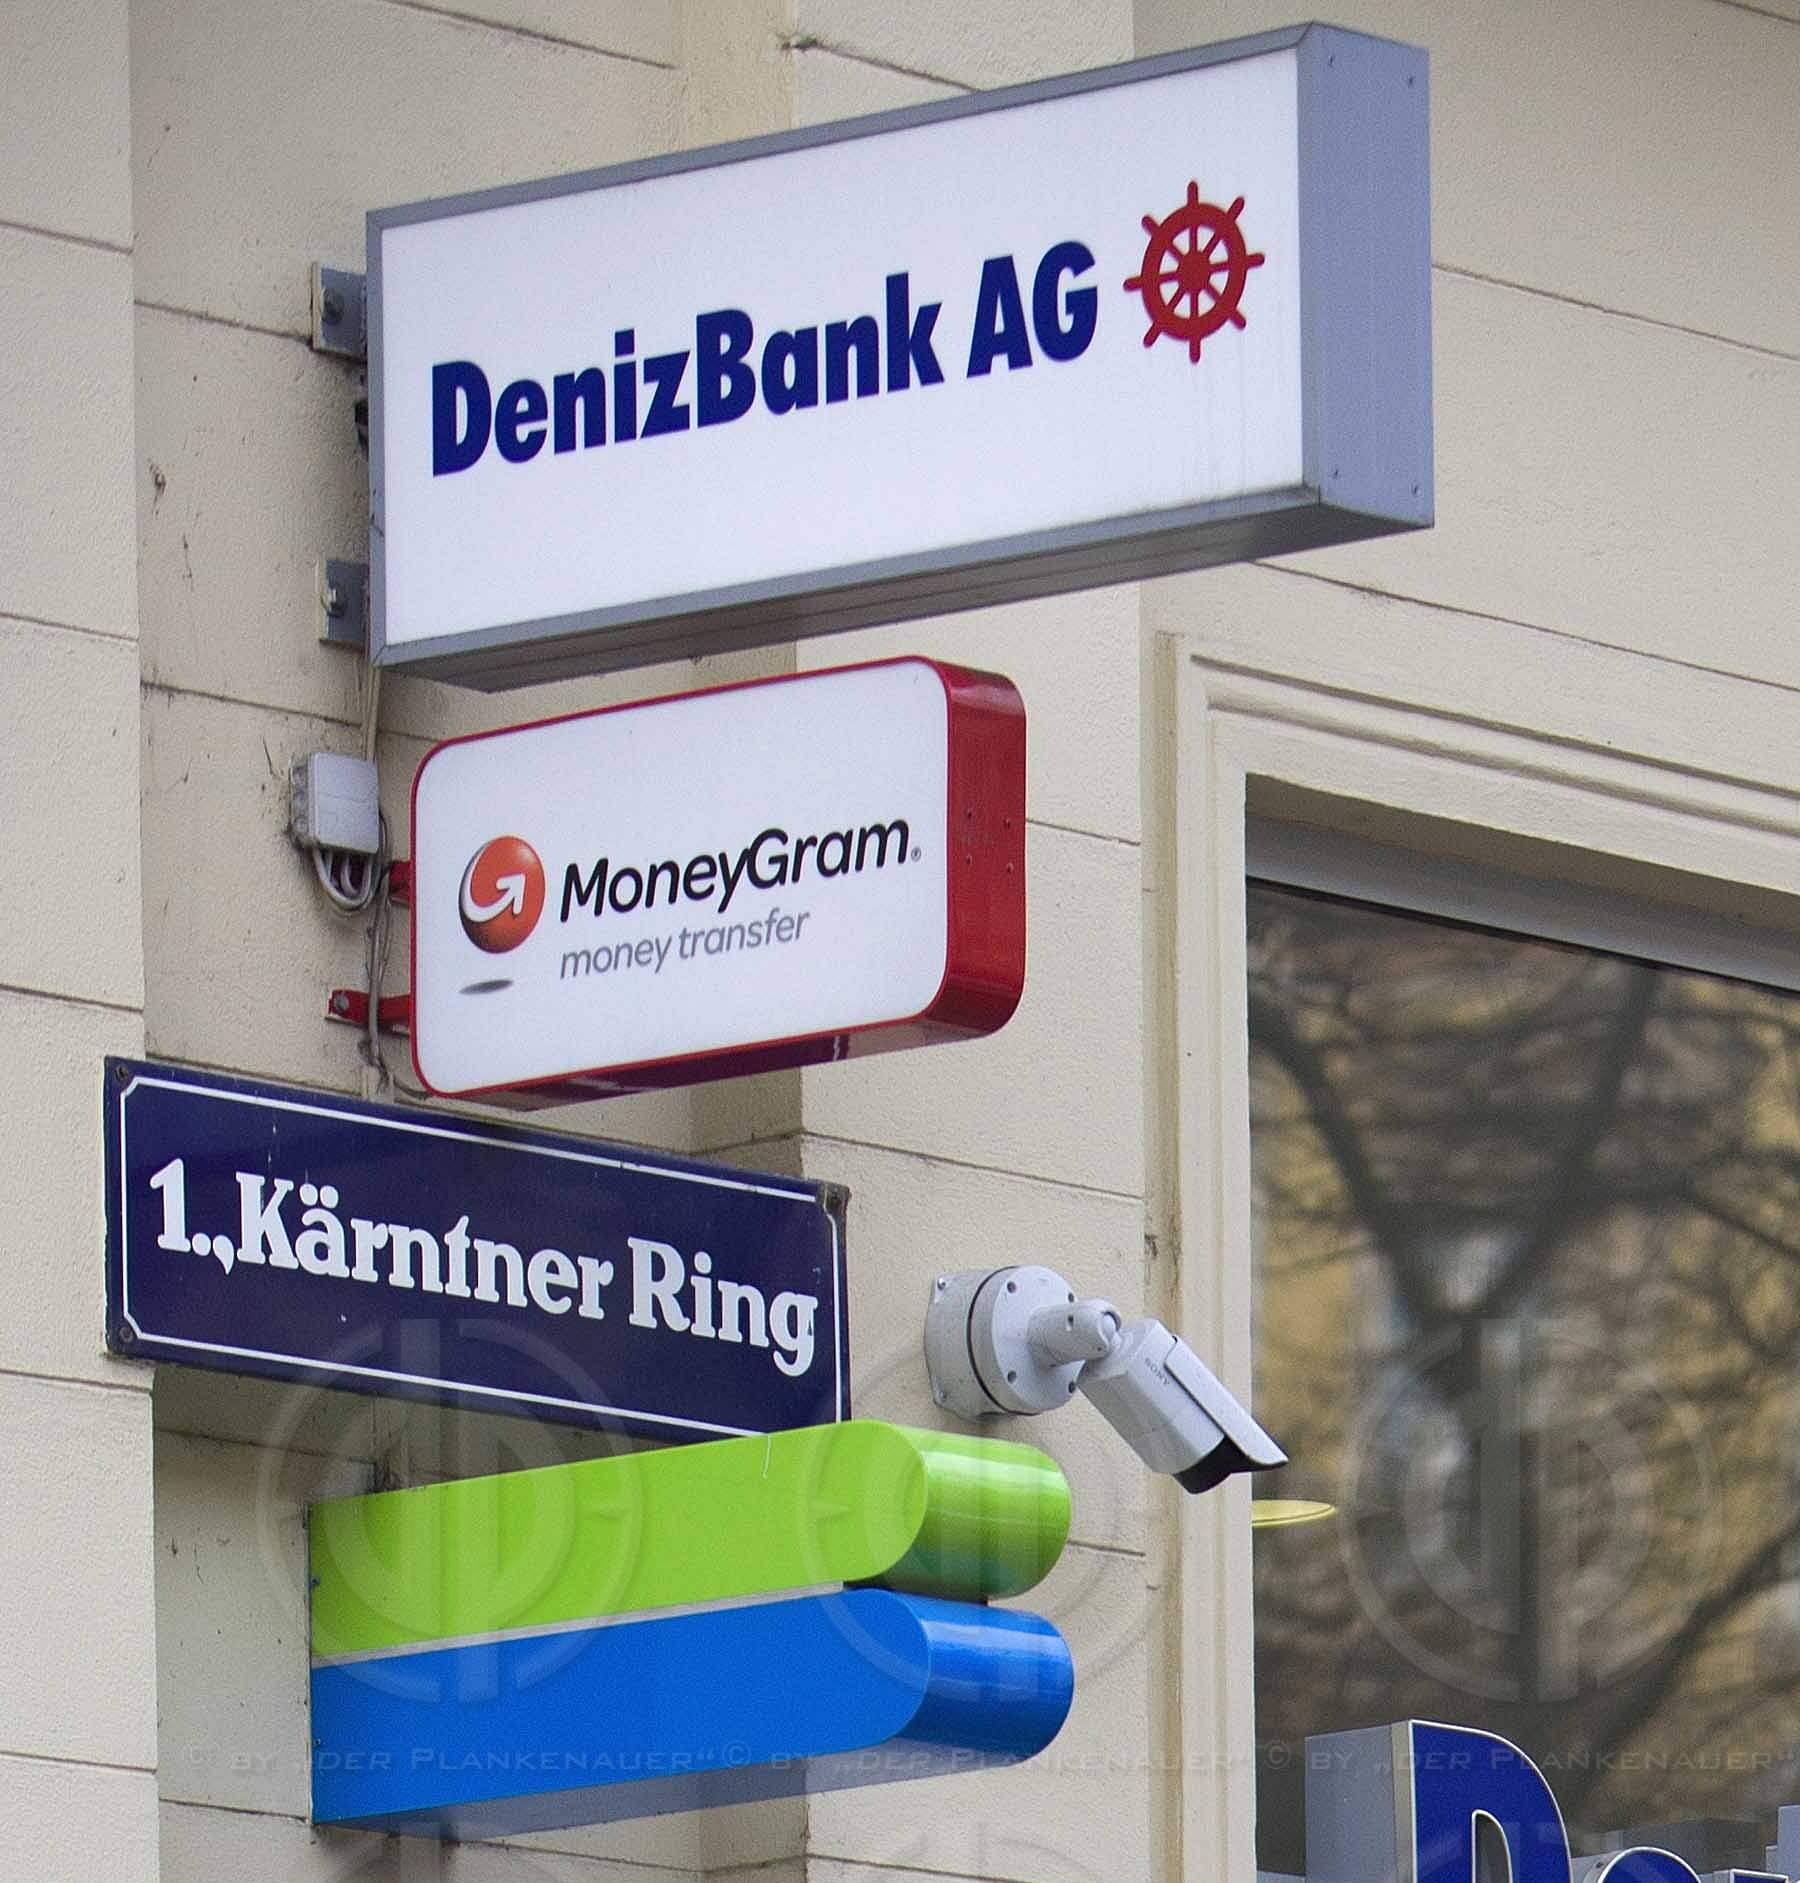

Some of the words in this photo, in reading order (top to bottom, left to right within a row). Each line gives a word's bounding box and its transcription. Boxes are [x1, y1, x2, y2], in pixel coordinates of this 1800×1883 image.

[432, 271, 944, 478] DenizBank
[967, 240, 1098, 379] AG
[559, 935, 673, 980] money
[679, 907, 811, 961] transfer
[628, 1237, 818, 1377] Ring
